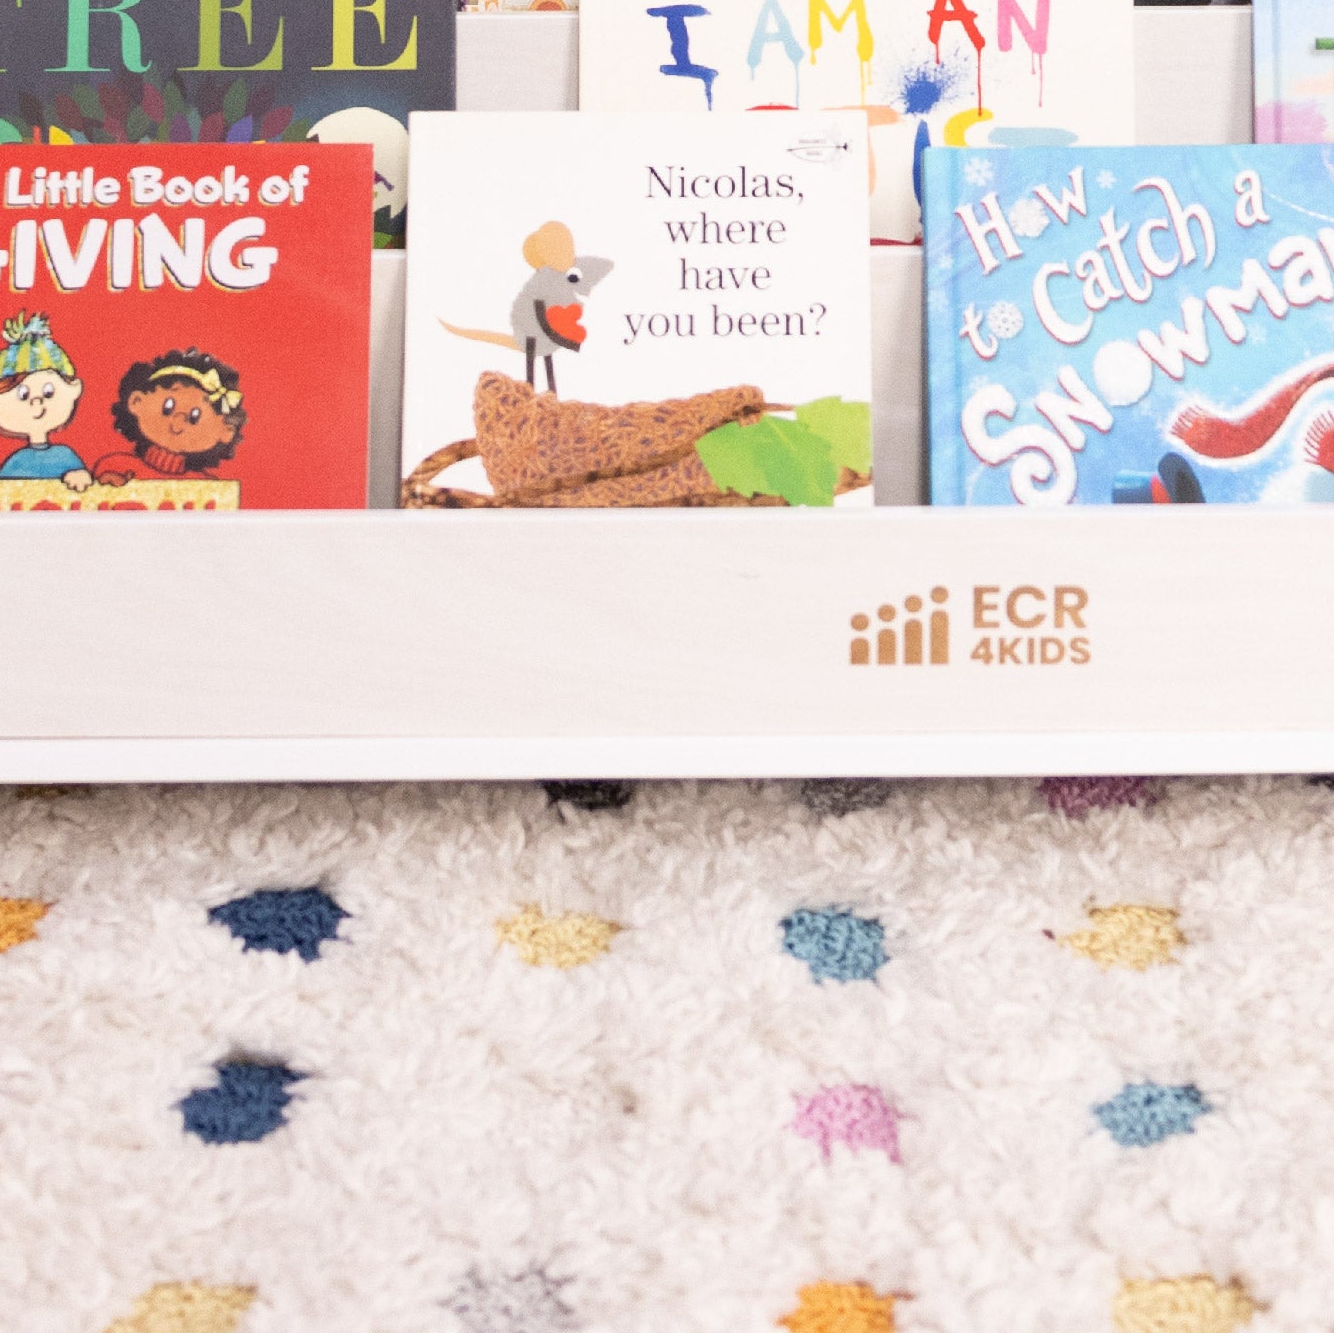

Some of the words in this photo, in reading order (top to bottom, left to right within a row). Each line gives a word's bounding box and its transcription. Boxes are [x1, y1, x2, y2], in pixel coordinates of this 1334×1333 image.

[646, 3, 719, 85] I
[4, 166, 120, 207] Little
[128, 165, 250, 206] Book
[259, 165, 310, 205] of
[645, 165, 805, 204] Nicolas,
[664, 212, 787, 245] where
[679, 258, 773, 291] have
[1032, 175, 1216, 345] Catch
[1233, 169, 1270, 228] a
[623, 312, 696, 346] you
[711, 302, 829, 338] been?
[972, 584, 1089, 629] ECR
[970, 636, 1092, 665] 4KIDS
